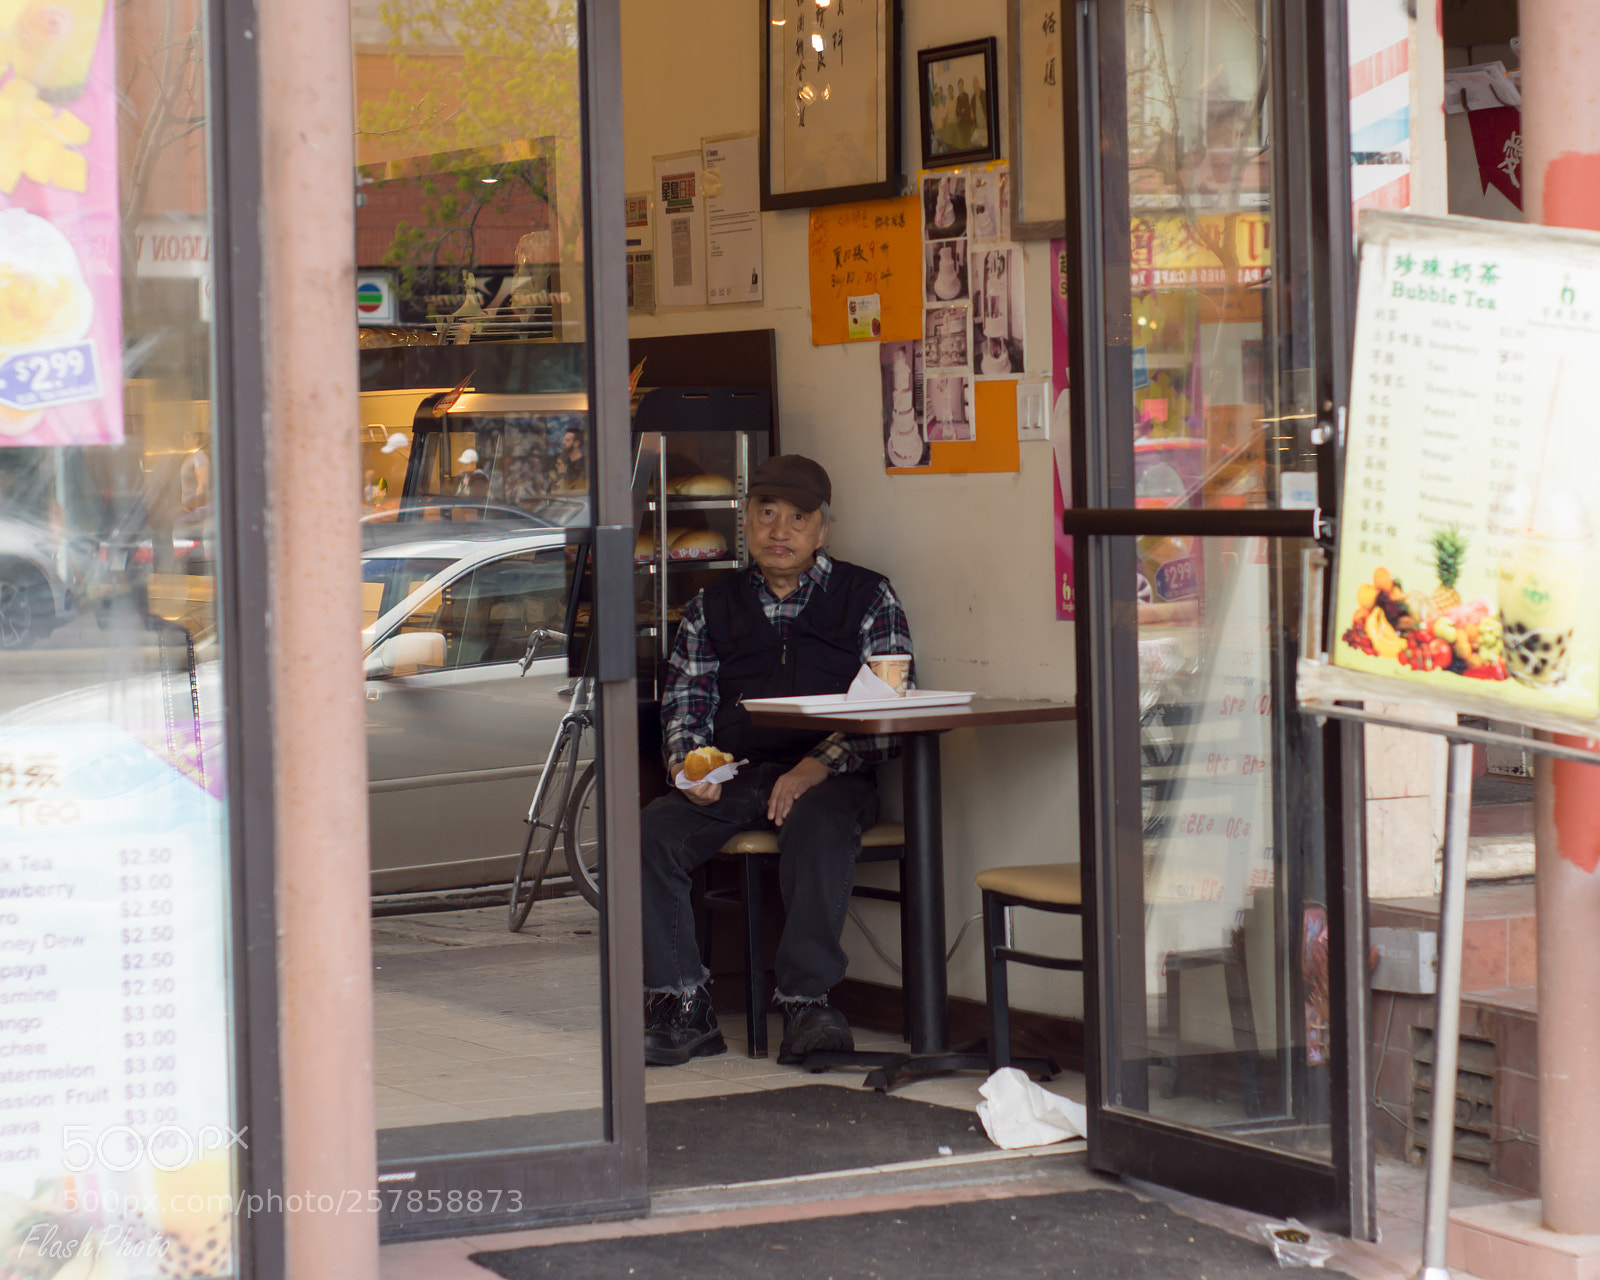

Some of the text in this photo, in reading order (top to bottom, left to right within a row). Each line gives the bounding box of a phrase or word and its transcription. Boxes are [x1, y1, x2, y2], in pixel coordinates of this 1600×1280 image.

[1394, 252, 1500, 286] 珍珠奶茶
[1391, 281, 1496, 311] Bubble Tea
[14, 350, 85, 391] $2.99
[1164, 562, 1191, 589] $2.99
[8, 796, 82, 827] Tea
[19, 855, 53, 872] Tea
[43, 932, 87, 949] Dew
[65, 1087, 109, 1105] Fruit
[0, 1145, 40, 1162] ach
